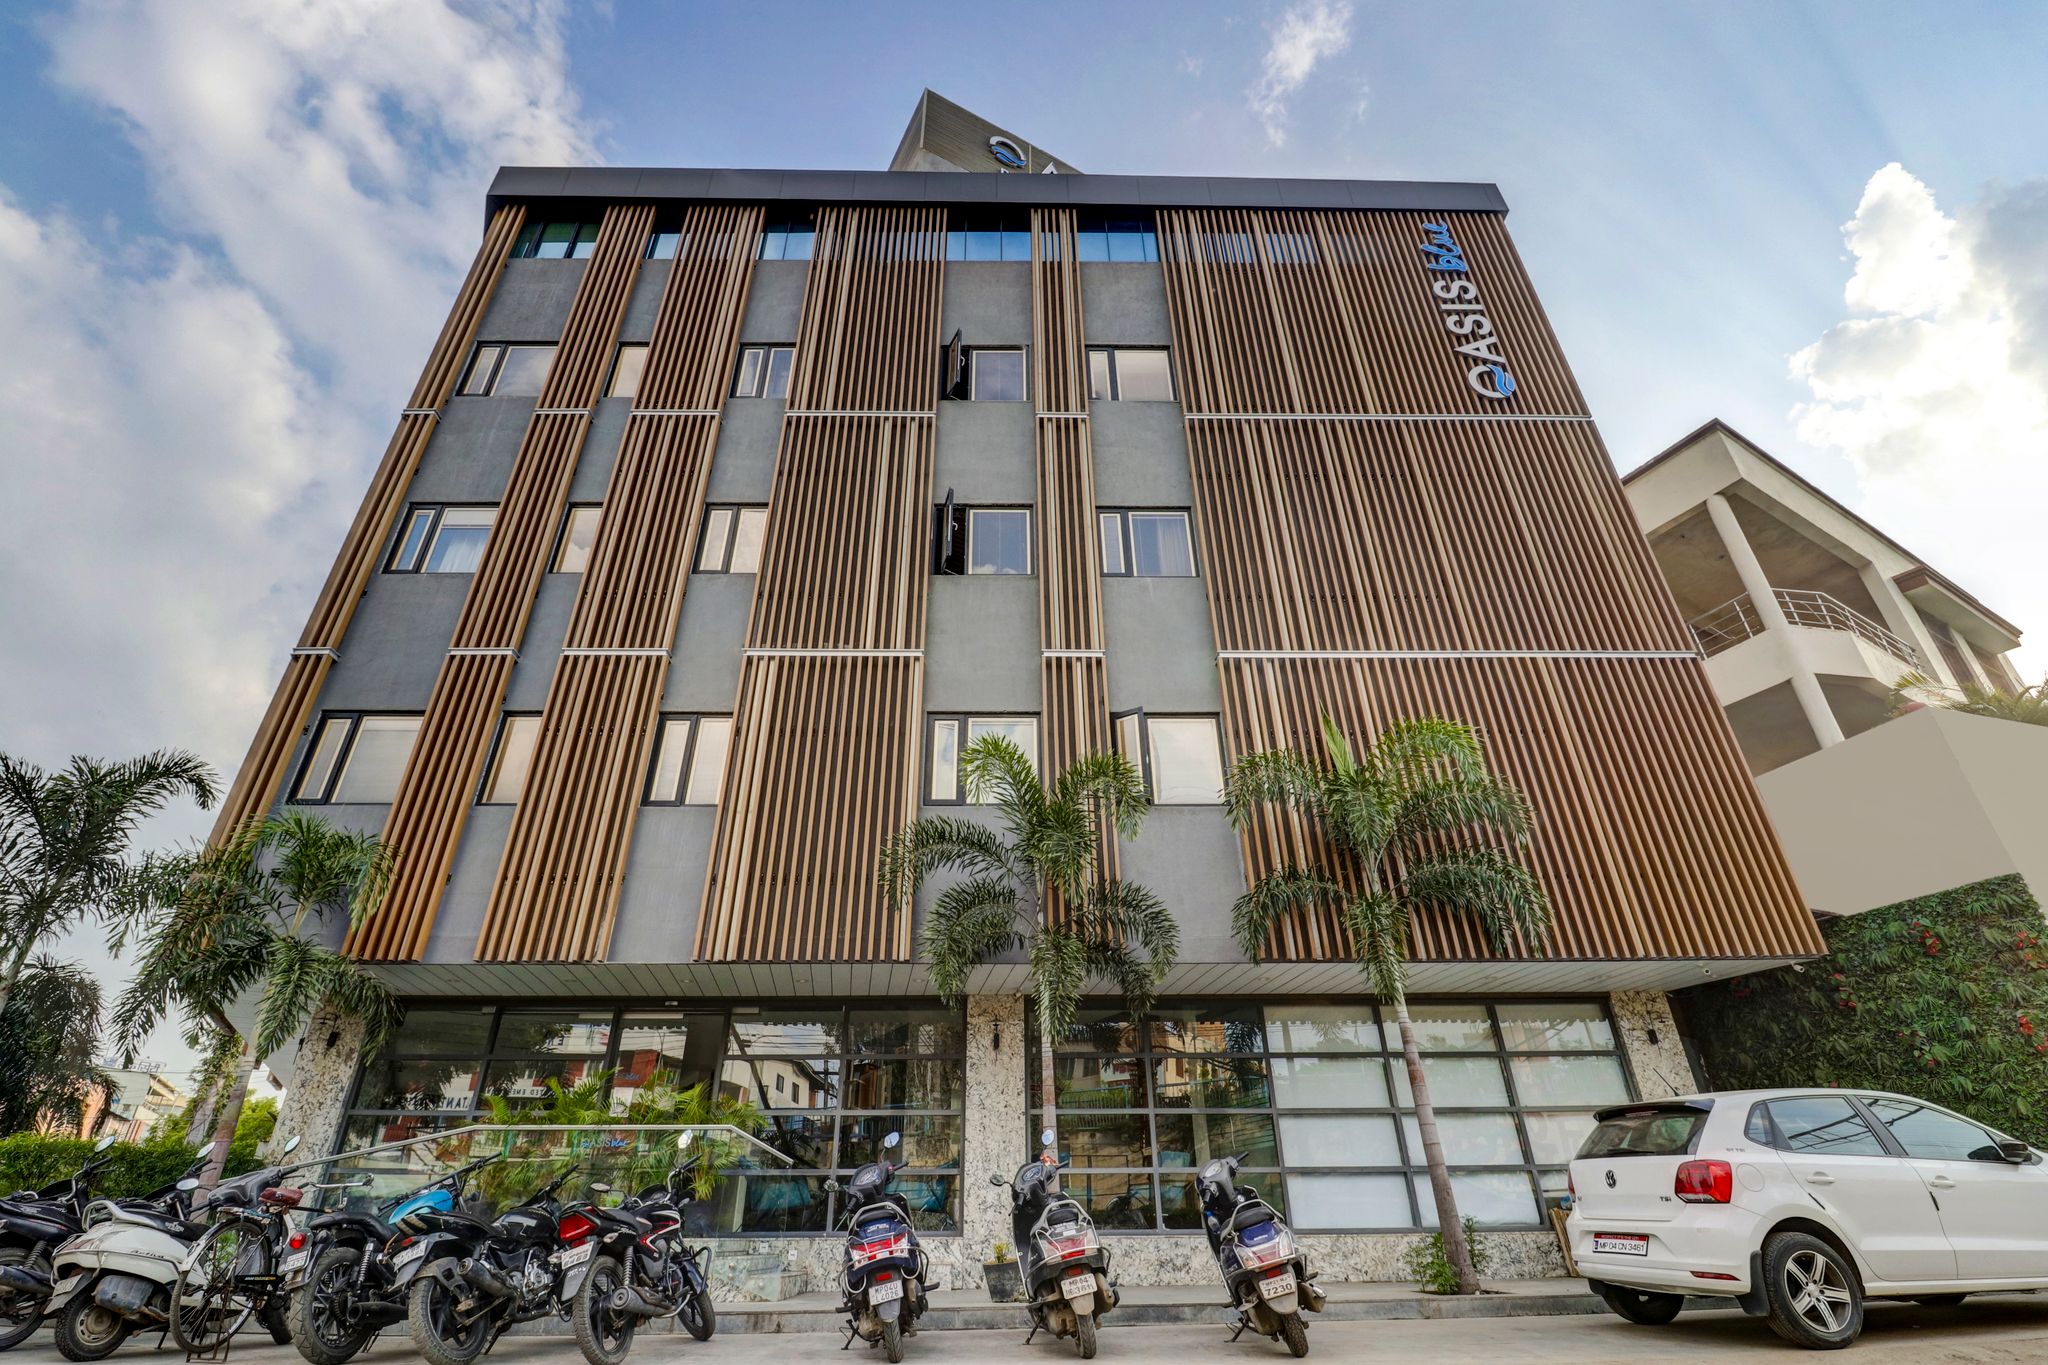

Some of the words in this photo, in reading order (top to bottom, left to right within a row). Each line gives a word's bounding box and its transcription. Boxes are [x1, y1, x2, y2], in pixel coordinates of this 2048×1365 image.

[1420, 220, 1468, 272] blue
[1433, 279, 1517, 399] OASIS
[1264, 1283, 1292, 1296] 7230
